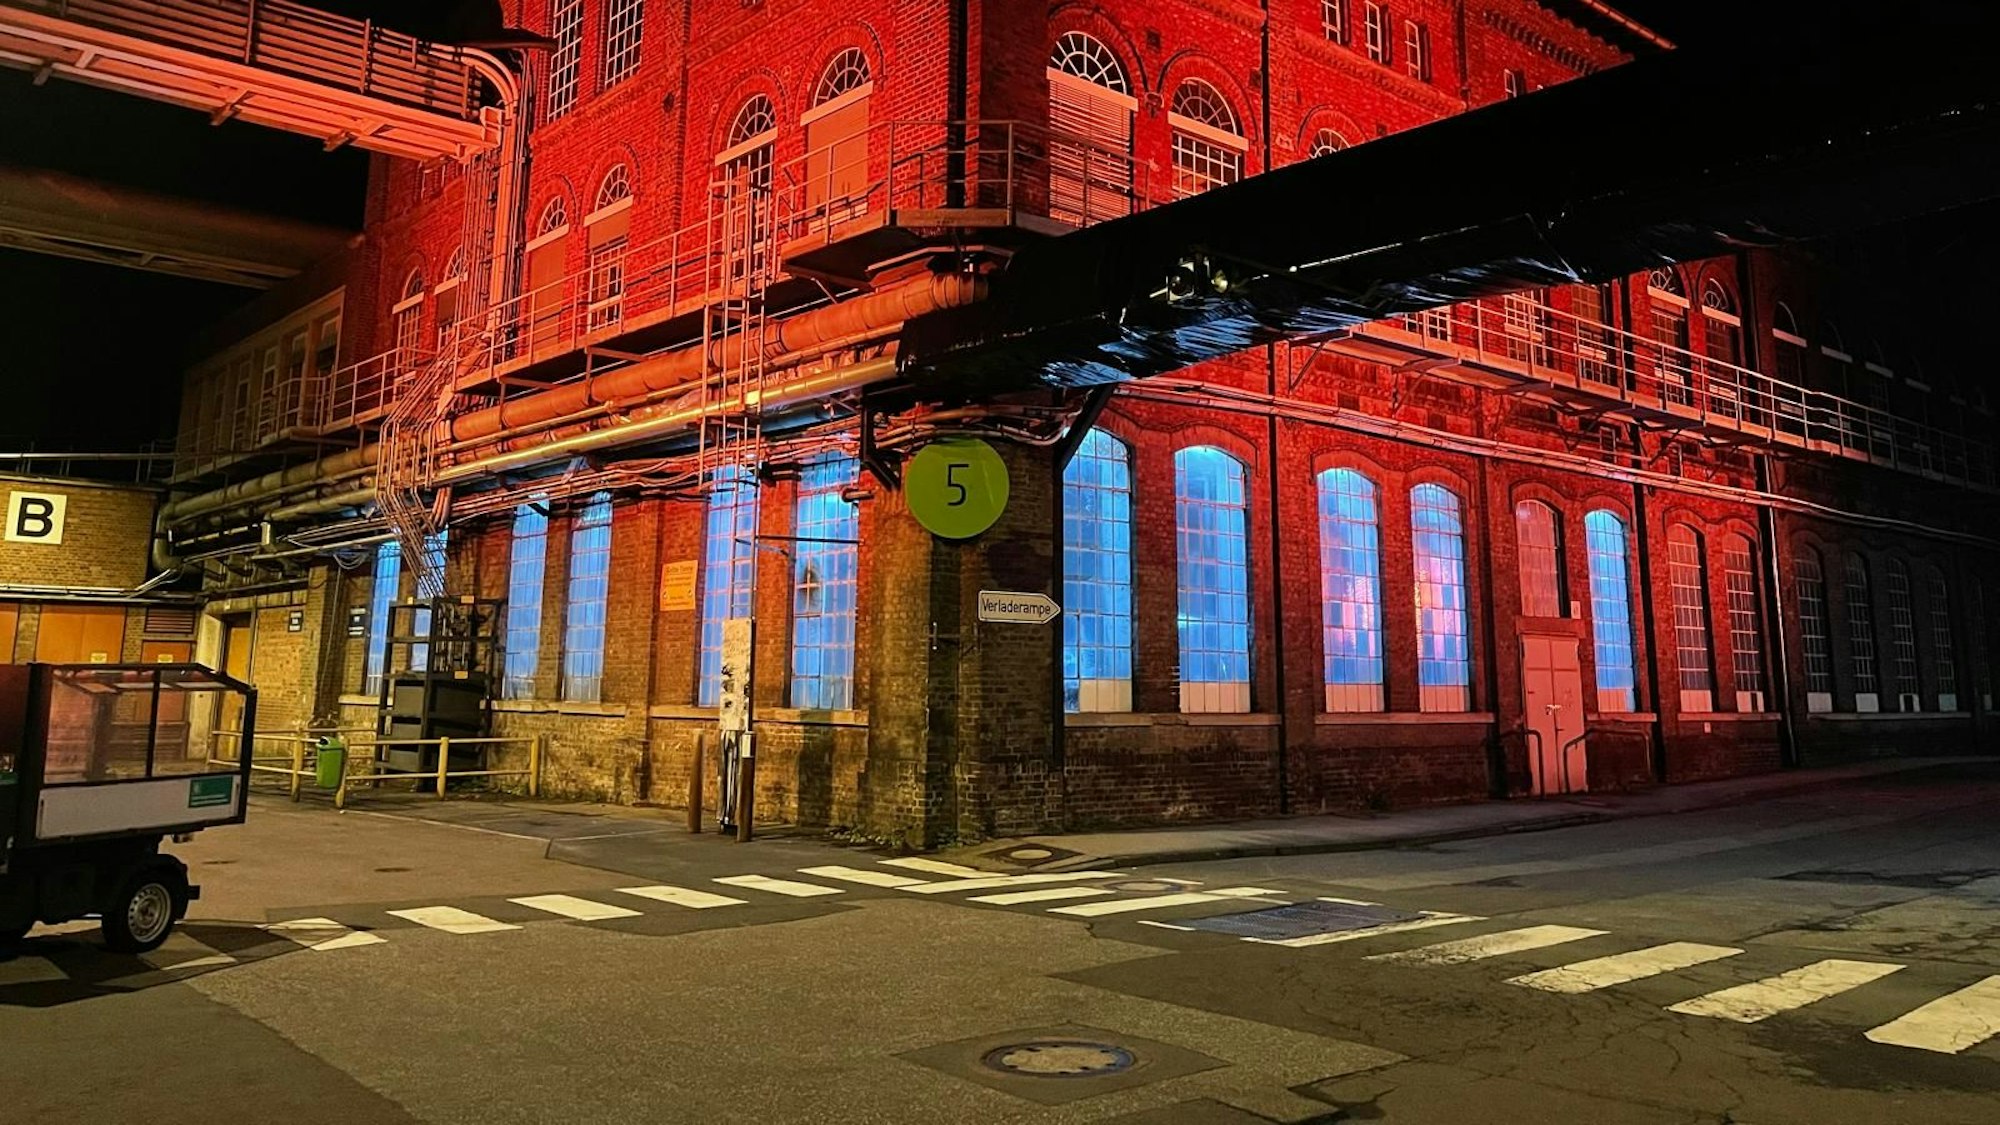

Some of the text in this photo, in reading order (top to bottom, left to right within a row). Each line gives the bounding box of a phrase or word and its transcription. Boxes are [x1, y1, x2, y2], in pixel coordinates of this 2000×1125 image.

[946, 463, 970, 506] 5
[16, 497, 53, 537] B
[982, 597, 1051, 617] Verladerampe
